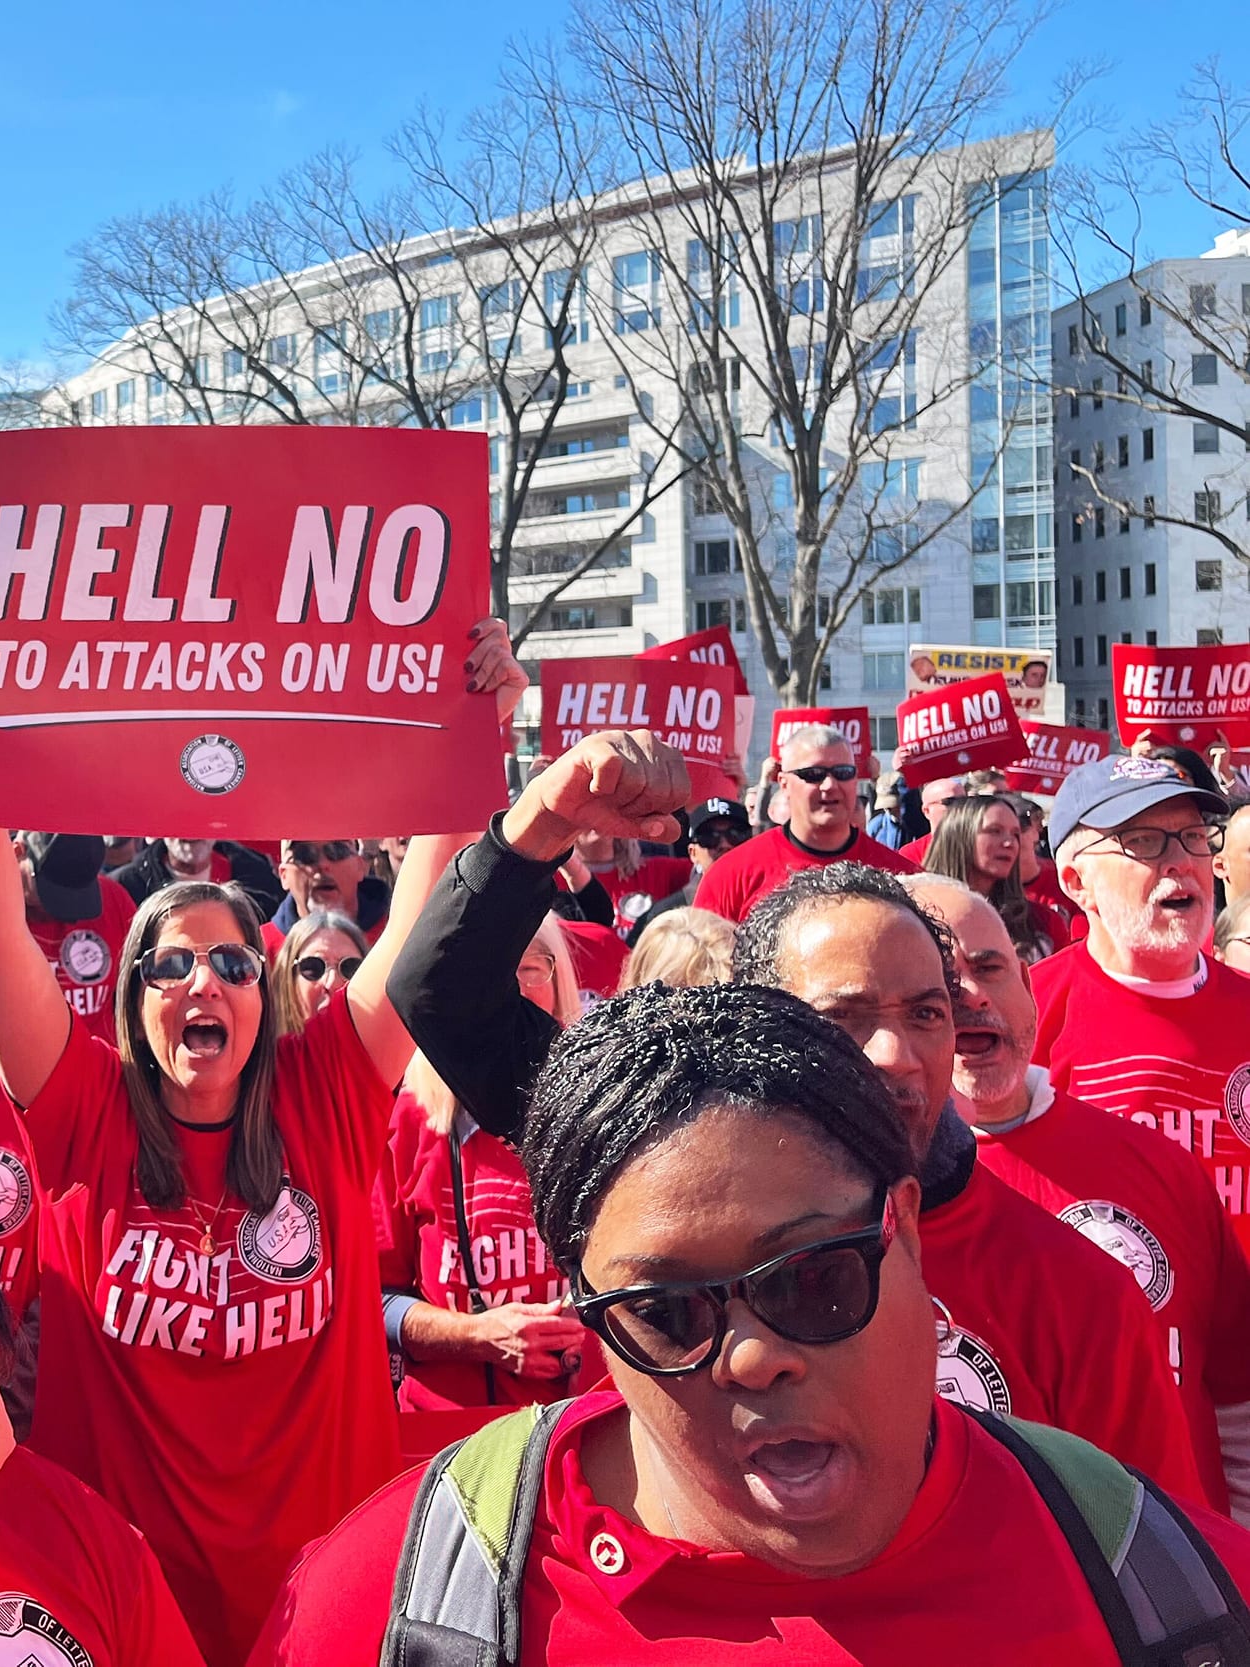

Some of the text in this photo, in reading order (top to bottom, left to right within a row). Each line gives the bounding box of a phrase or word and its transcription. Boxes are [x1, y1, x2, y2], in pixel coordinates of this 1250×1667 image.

[276, 503, 451, 627] NO
[58, 640, 264, 692] ATTACKS
[281, 642, 350, 693] ON
[366, 643, 444, 695] US!
[938, 654, 1022, 669] RESIST
[1123, 661, 1250, 698] HELL NO
[556, 683, 721, 730] HELL NO
[903, 690, 1000, 743] HELL NO
[1126, 698, 1142, 714] TO
[1143, 700, 1204, 716] ATTACKS
[1208, 699, 1227, 714] ON
[561, 729, 583, 748] TO
[667, 731, 691, 750] ON
[697, 734, 722, 754] US!
[923, 729, 968, 752] ATTACKS
[971, 724, 987, 740] ON
[989, 718, 1008, 735] US!
[1023, 732, 1100, 763] ELL NO
[65, 985, 109, 1016] ELL!
[106, 1229, 231, 1306] FIGHT
[102, 1267, 333, 1360] LIKE HELL!
[972, 1353, 1008, 1414] OF LETTE
[37, 1614, 57, 1633] OF
[55, 1626, 88, 1667] LETTE
